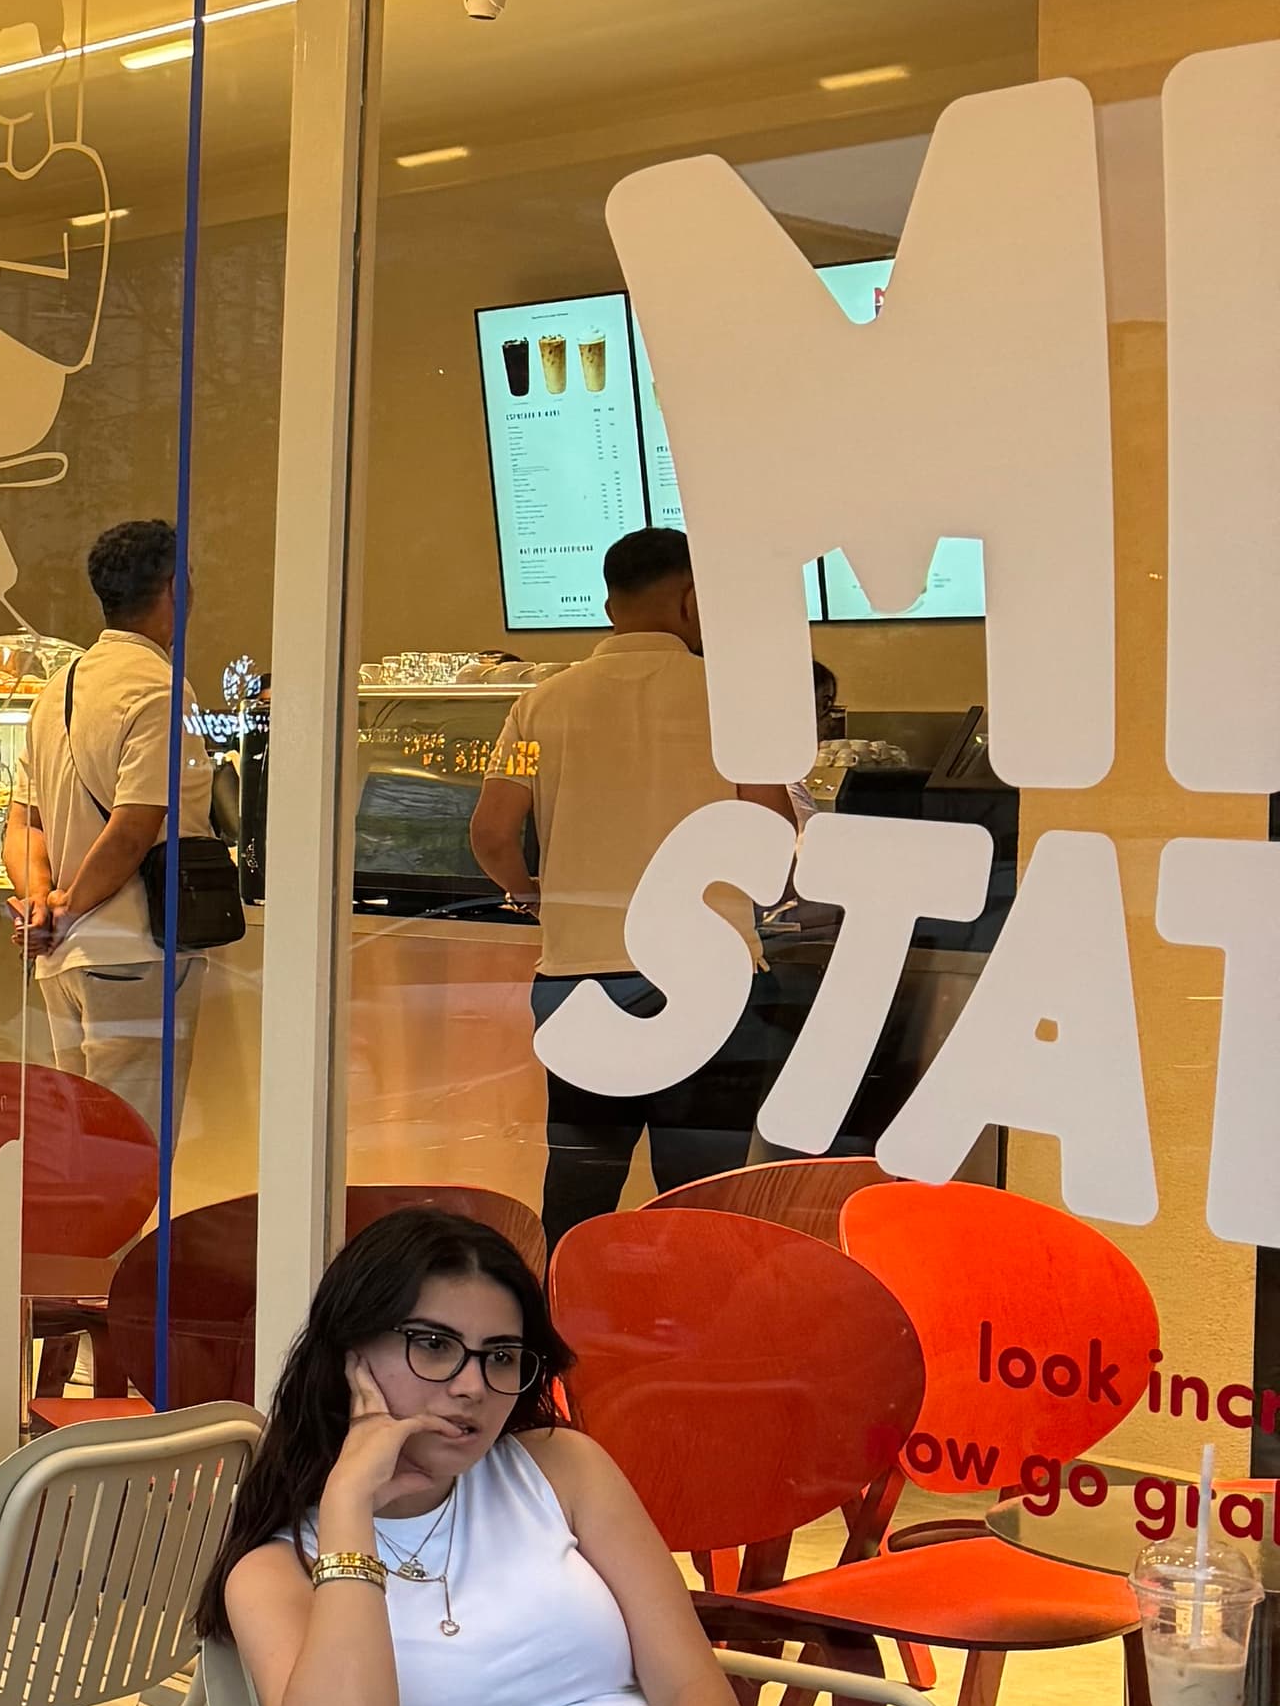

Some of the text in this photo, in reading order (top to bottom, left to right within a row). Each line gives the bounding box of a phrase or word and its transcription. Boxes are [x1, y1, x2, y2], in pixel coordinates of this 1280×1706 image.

[979, 1320, 1123, 1406] look
[1020, 1453, 1109, 1518] go
[1133, 1475, 1280, 1542] gra
